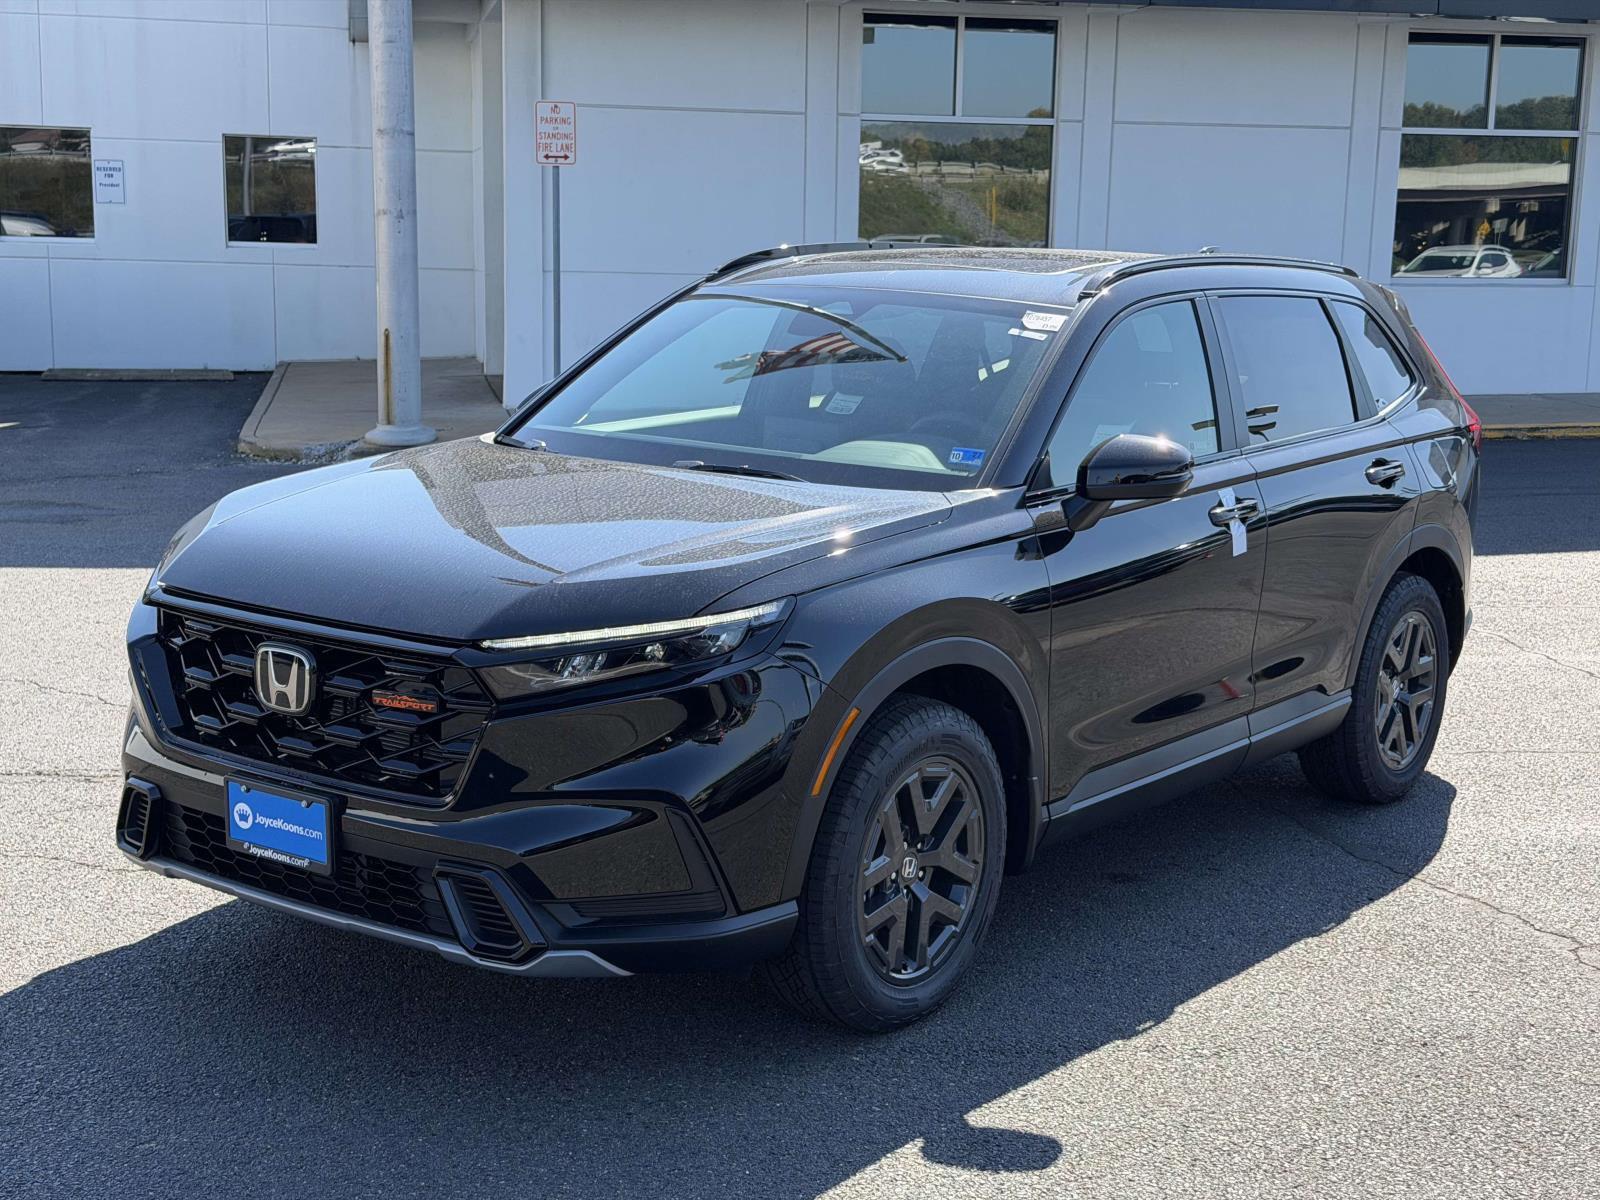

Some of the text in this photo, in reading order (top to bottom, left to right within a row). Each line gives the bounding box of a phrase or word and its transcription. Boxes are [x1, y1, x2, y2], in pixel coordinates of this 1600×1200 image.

[550, 105, 561, 115] NO
[540, 116, 572, 126] PARKING
[538, 131, 574, 141] STANDING
[537, 142, 574, 153] FIRE LANE
[373, 697, 435, 711] TRAILSPORT
[255, 812, 323, 841] JoyceKoons.com
[249, 843, 306, 868] JoyceKoons.com
